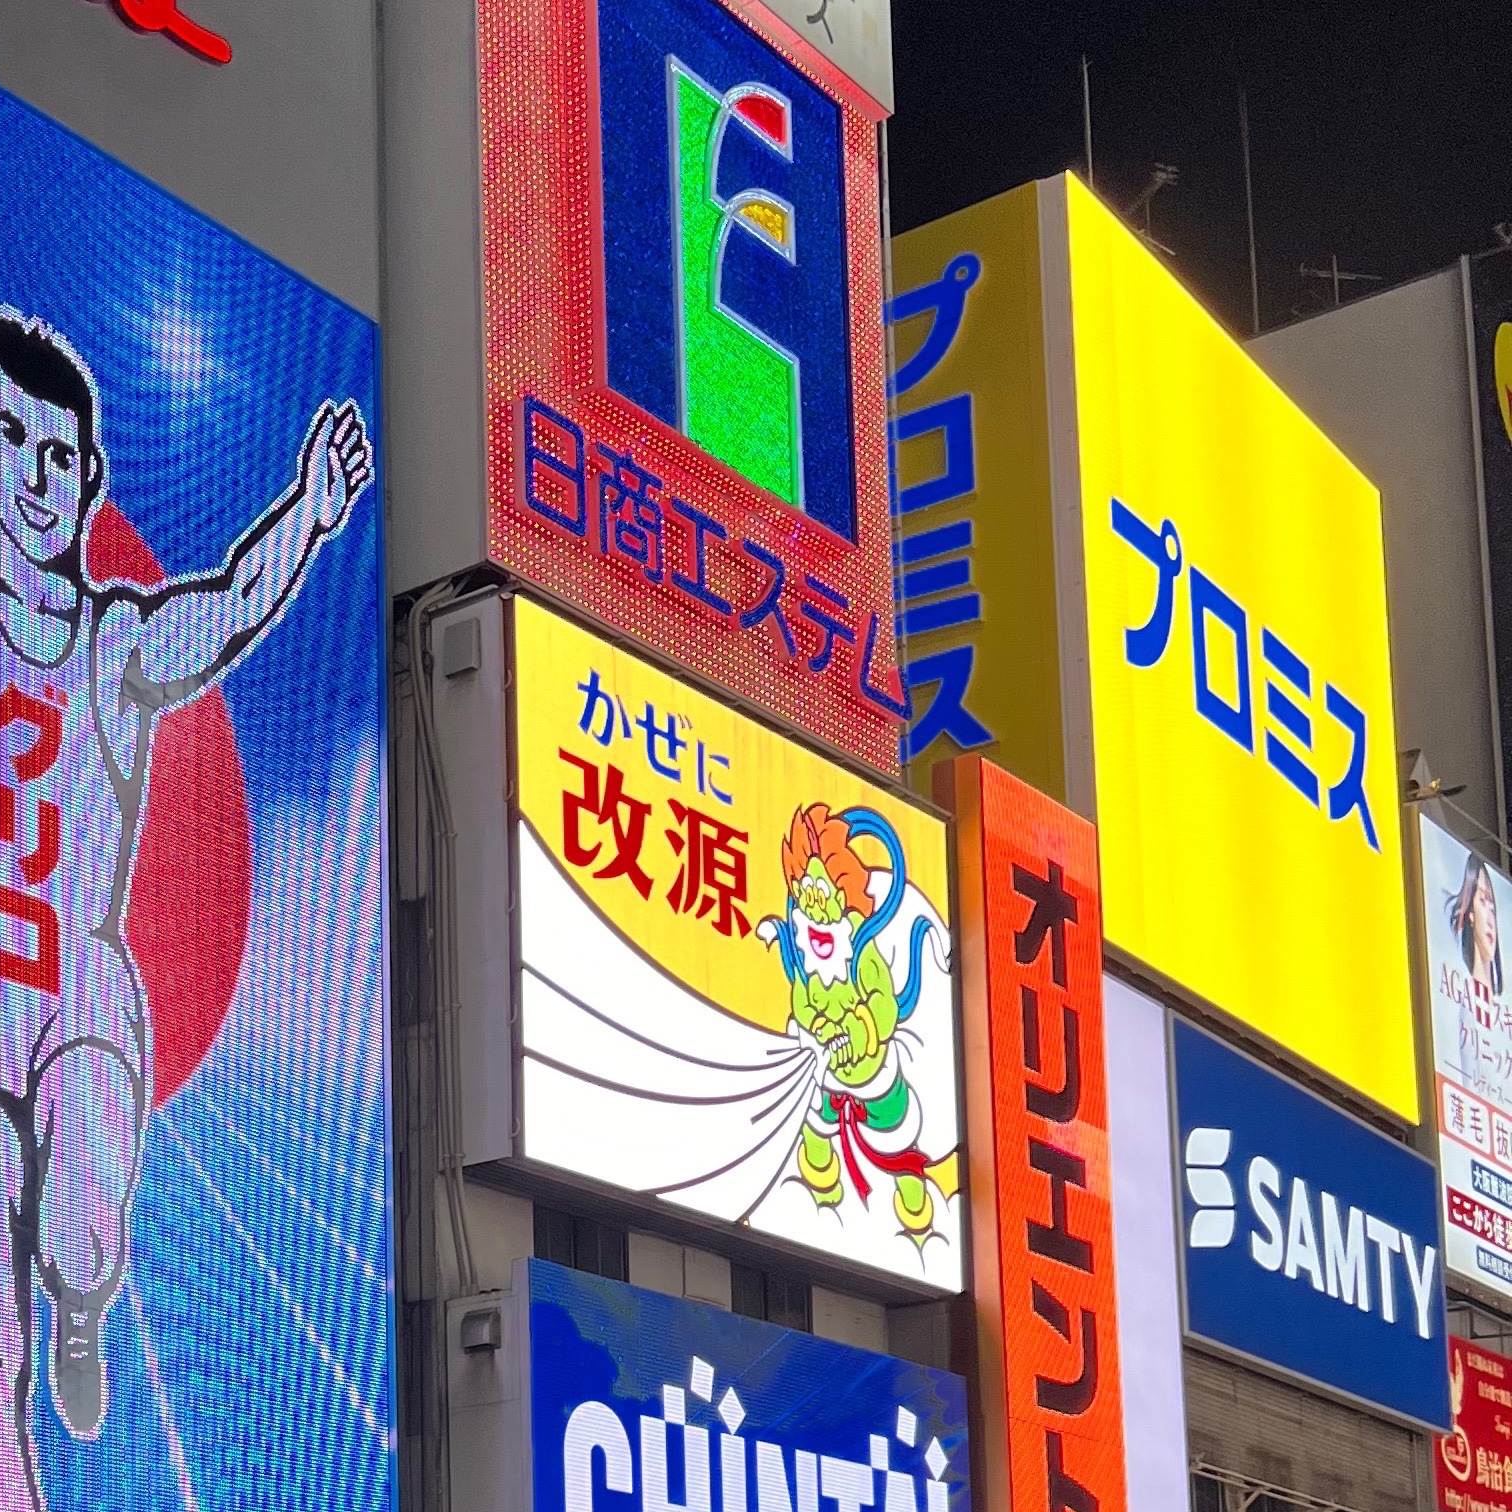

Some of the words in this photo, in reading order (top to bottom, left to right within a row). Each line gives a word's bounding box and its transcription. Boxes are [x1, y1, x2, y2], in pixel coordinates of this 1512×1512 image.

[522, 394, 912, 722] 日商エステム
[882, 252, 994, 762] プロミス
[577, 666, 733, 805] かぜに
[1109, 496, 1382, 855] プロミス
[558, 747, 753, 940] 改源
[1440, 963, 1473, 1014] AGA
[1248, 1155, 1436, 1340] SAMTY
